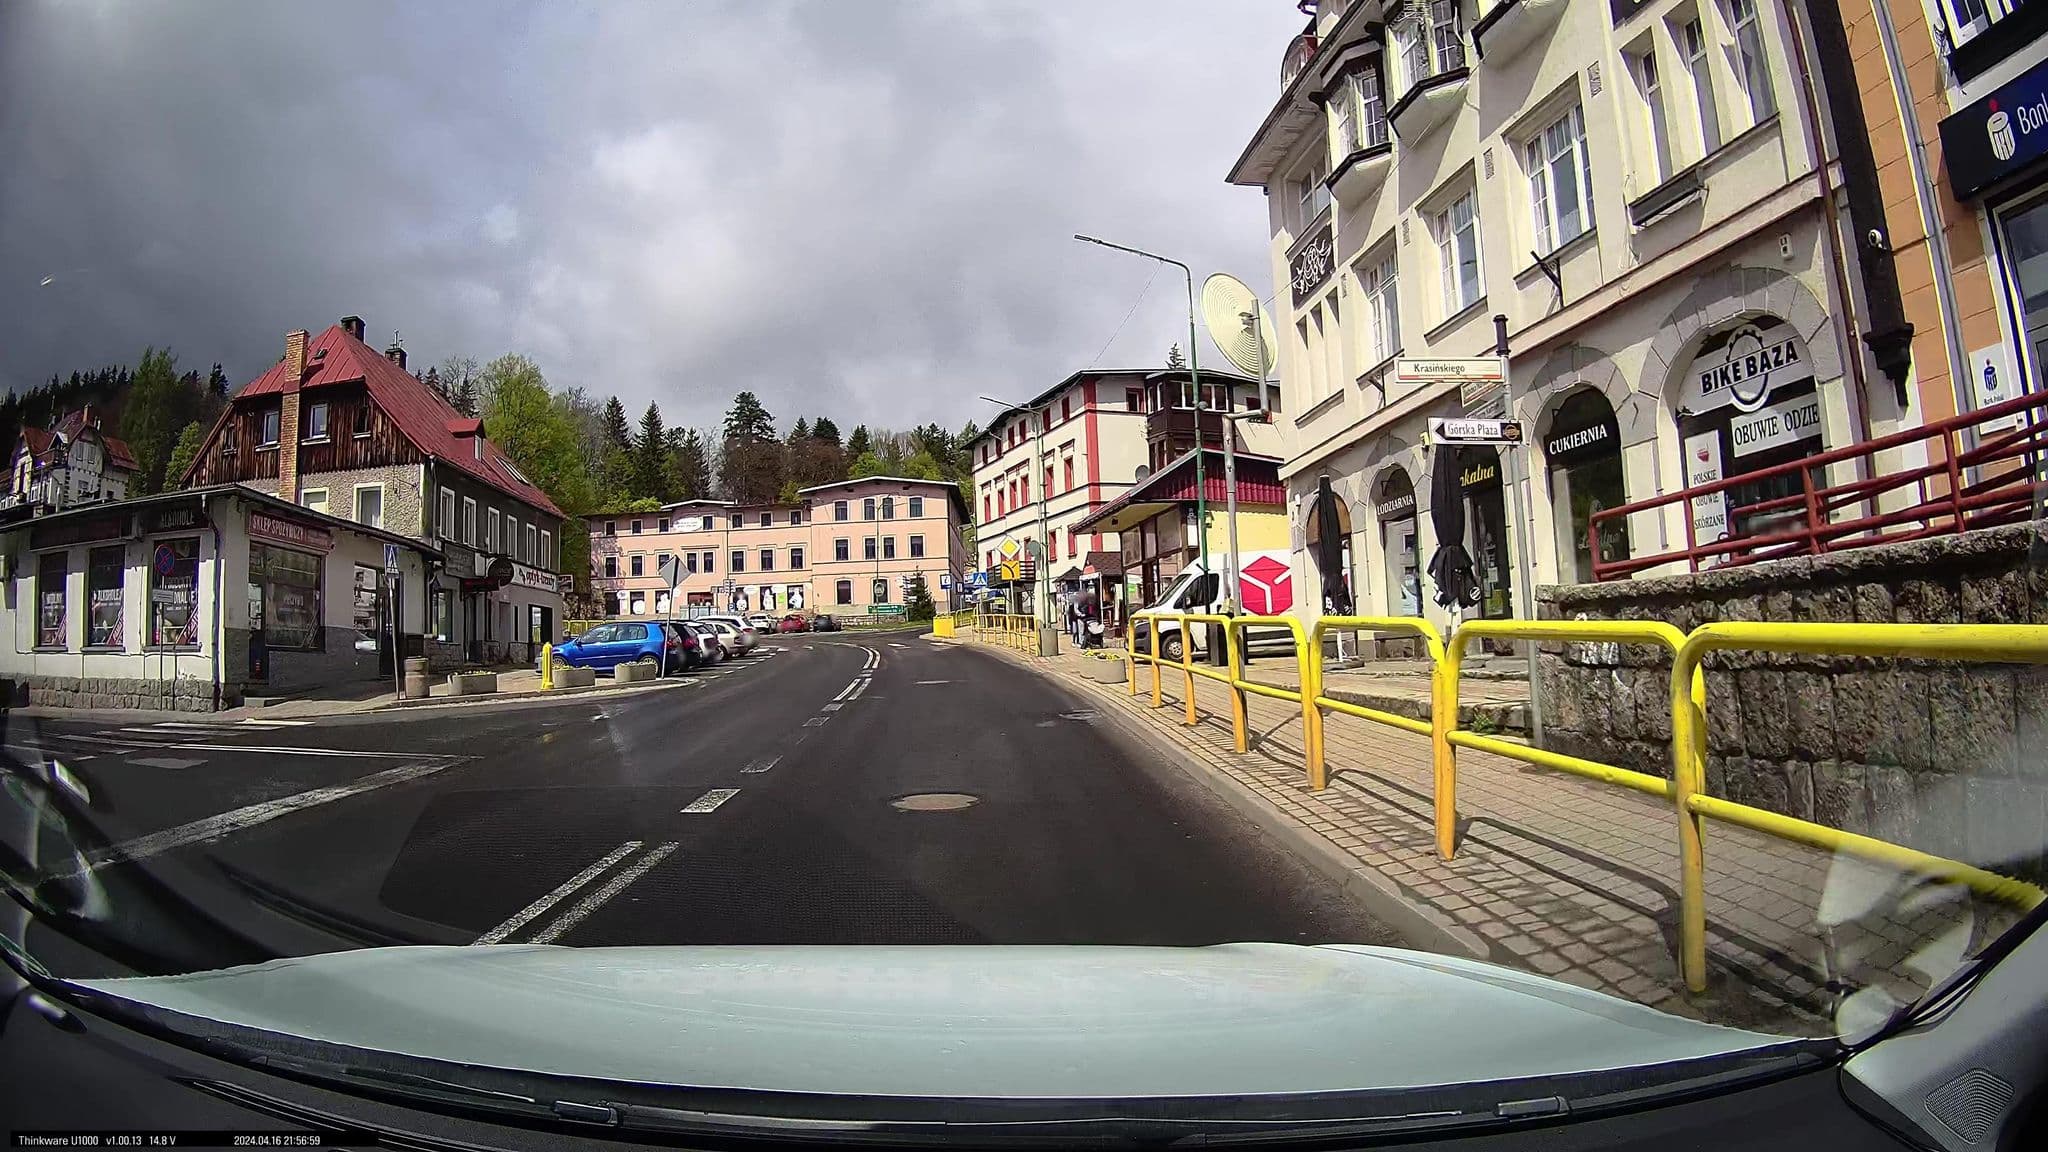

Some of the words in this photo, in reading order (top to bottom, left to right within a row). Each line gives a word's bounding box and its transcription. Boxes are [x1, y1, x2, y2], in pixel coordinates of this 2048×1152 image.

[1414, 363, 1466, 376] Krasińskiego
[1701, 362, 1742, 394] BIKE
[1745, 341, 1798, 378] BAZA
[1448, 423, 1476, 435] Górska
[1734, 416, 1779, 446] OBUWIE
[1549, 423, 1608, 455] CUKIERNIA
[1693, 469, 1717, 486] POLSKIE
[252, 515, 271, 532] SKLEP
